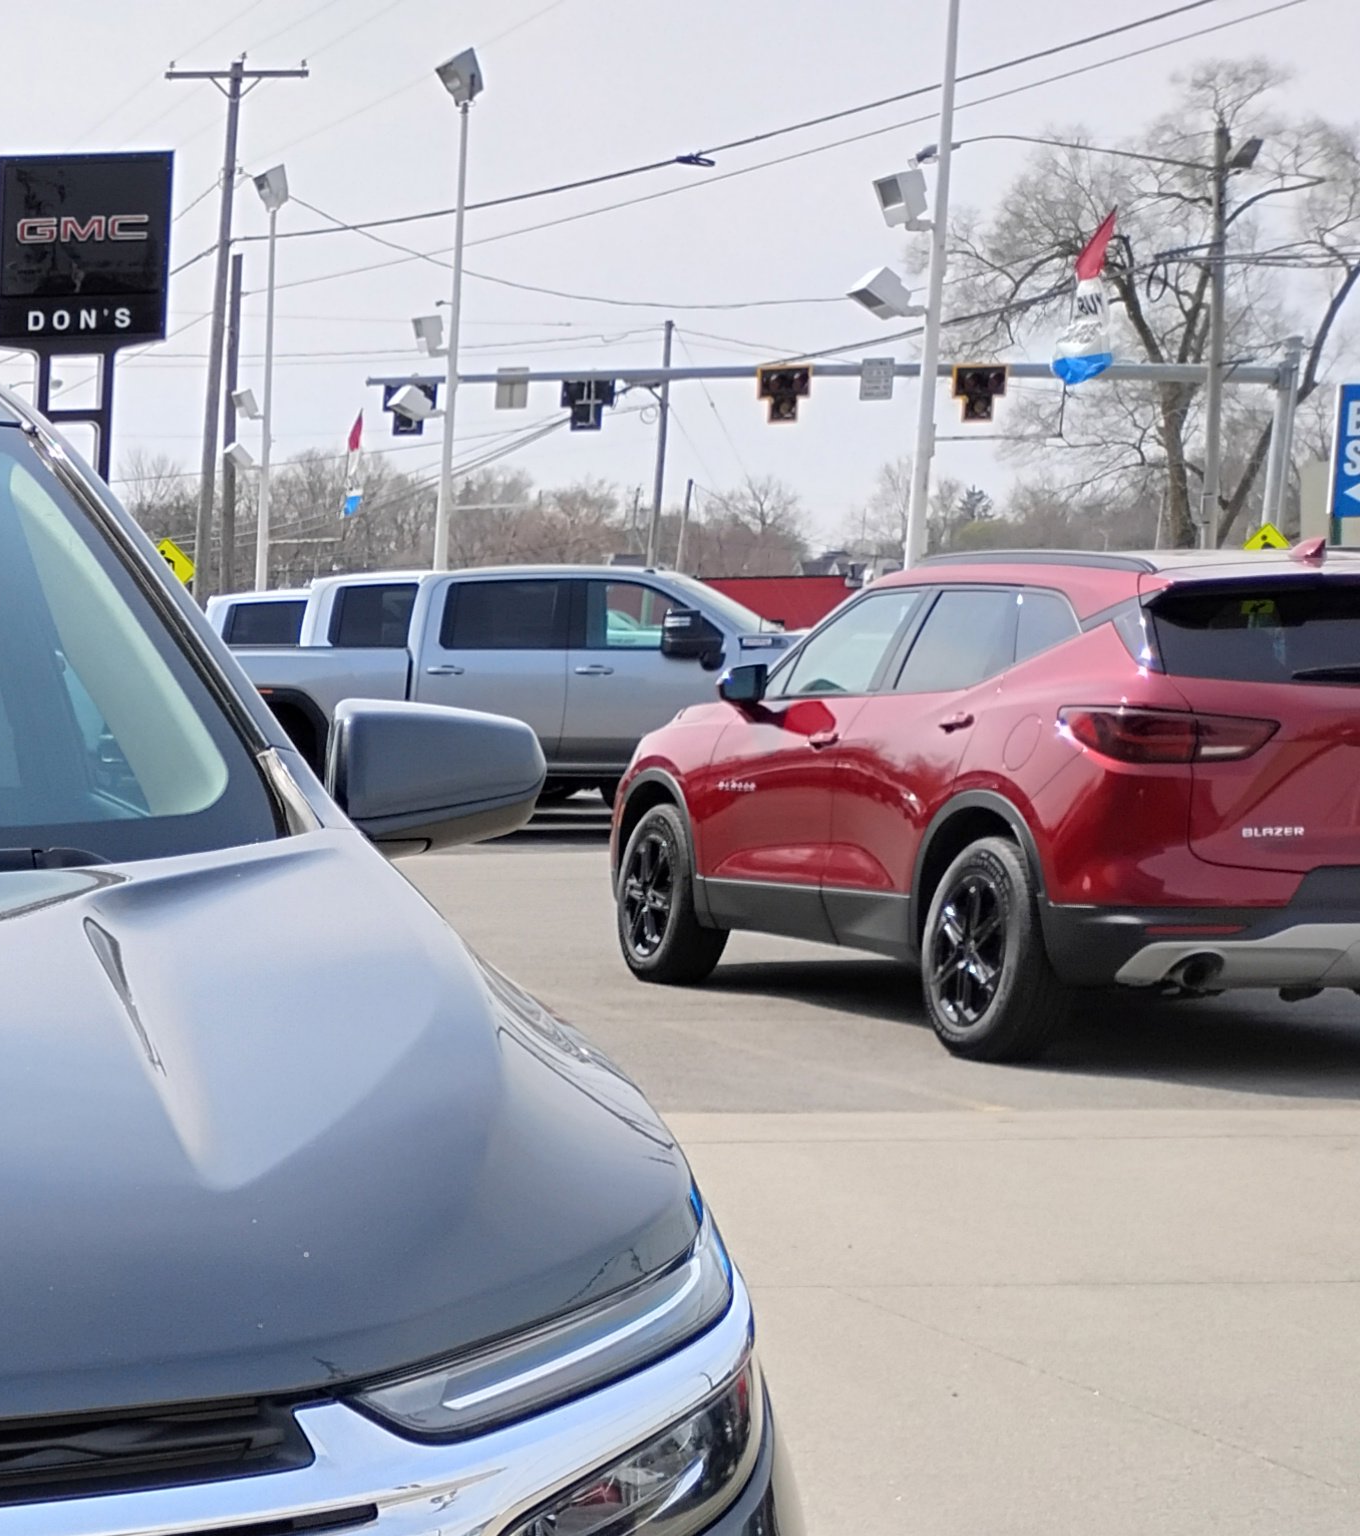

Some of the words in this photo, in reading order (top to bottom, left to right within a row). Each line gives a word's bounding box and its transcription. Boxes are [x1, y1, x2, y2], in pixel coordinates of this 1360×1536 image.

[17, 214, 148, 244] GMC
[27, 307, 131, 331] DON'S
[1242, 826, 1304, 838] BLAZER
